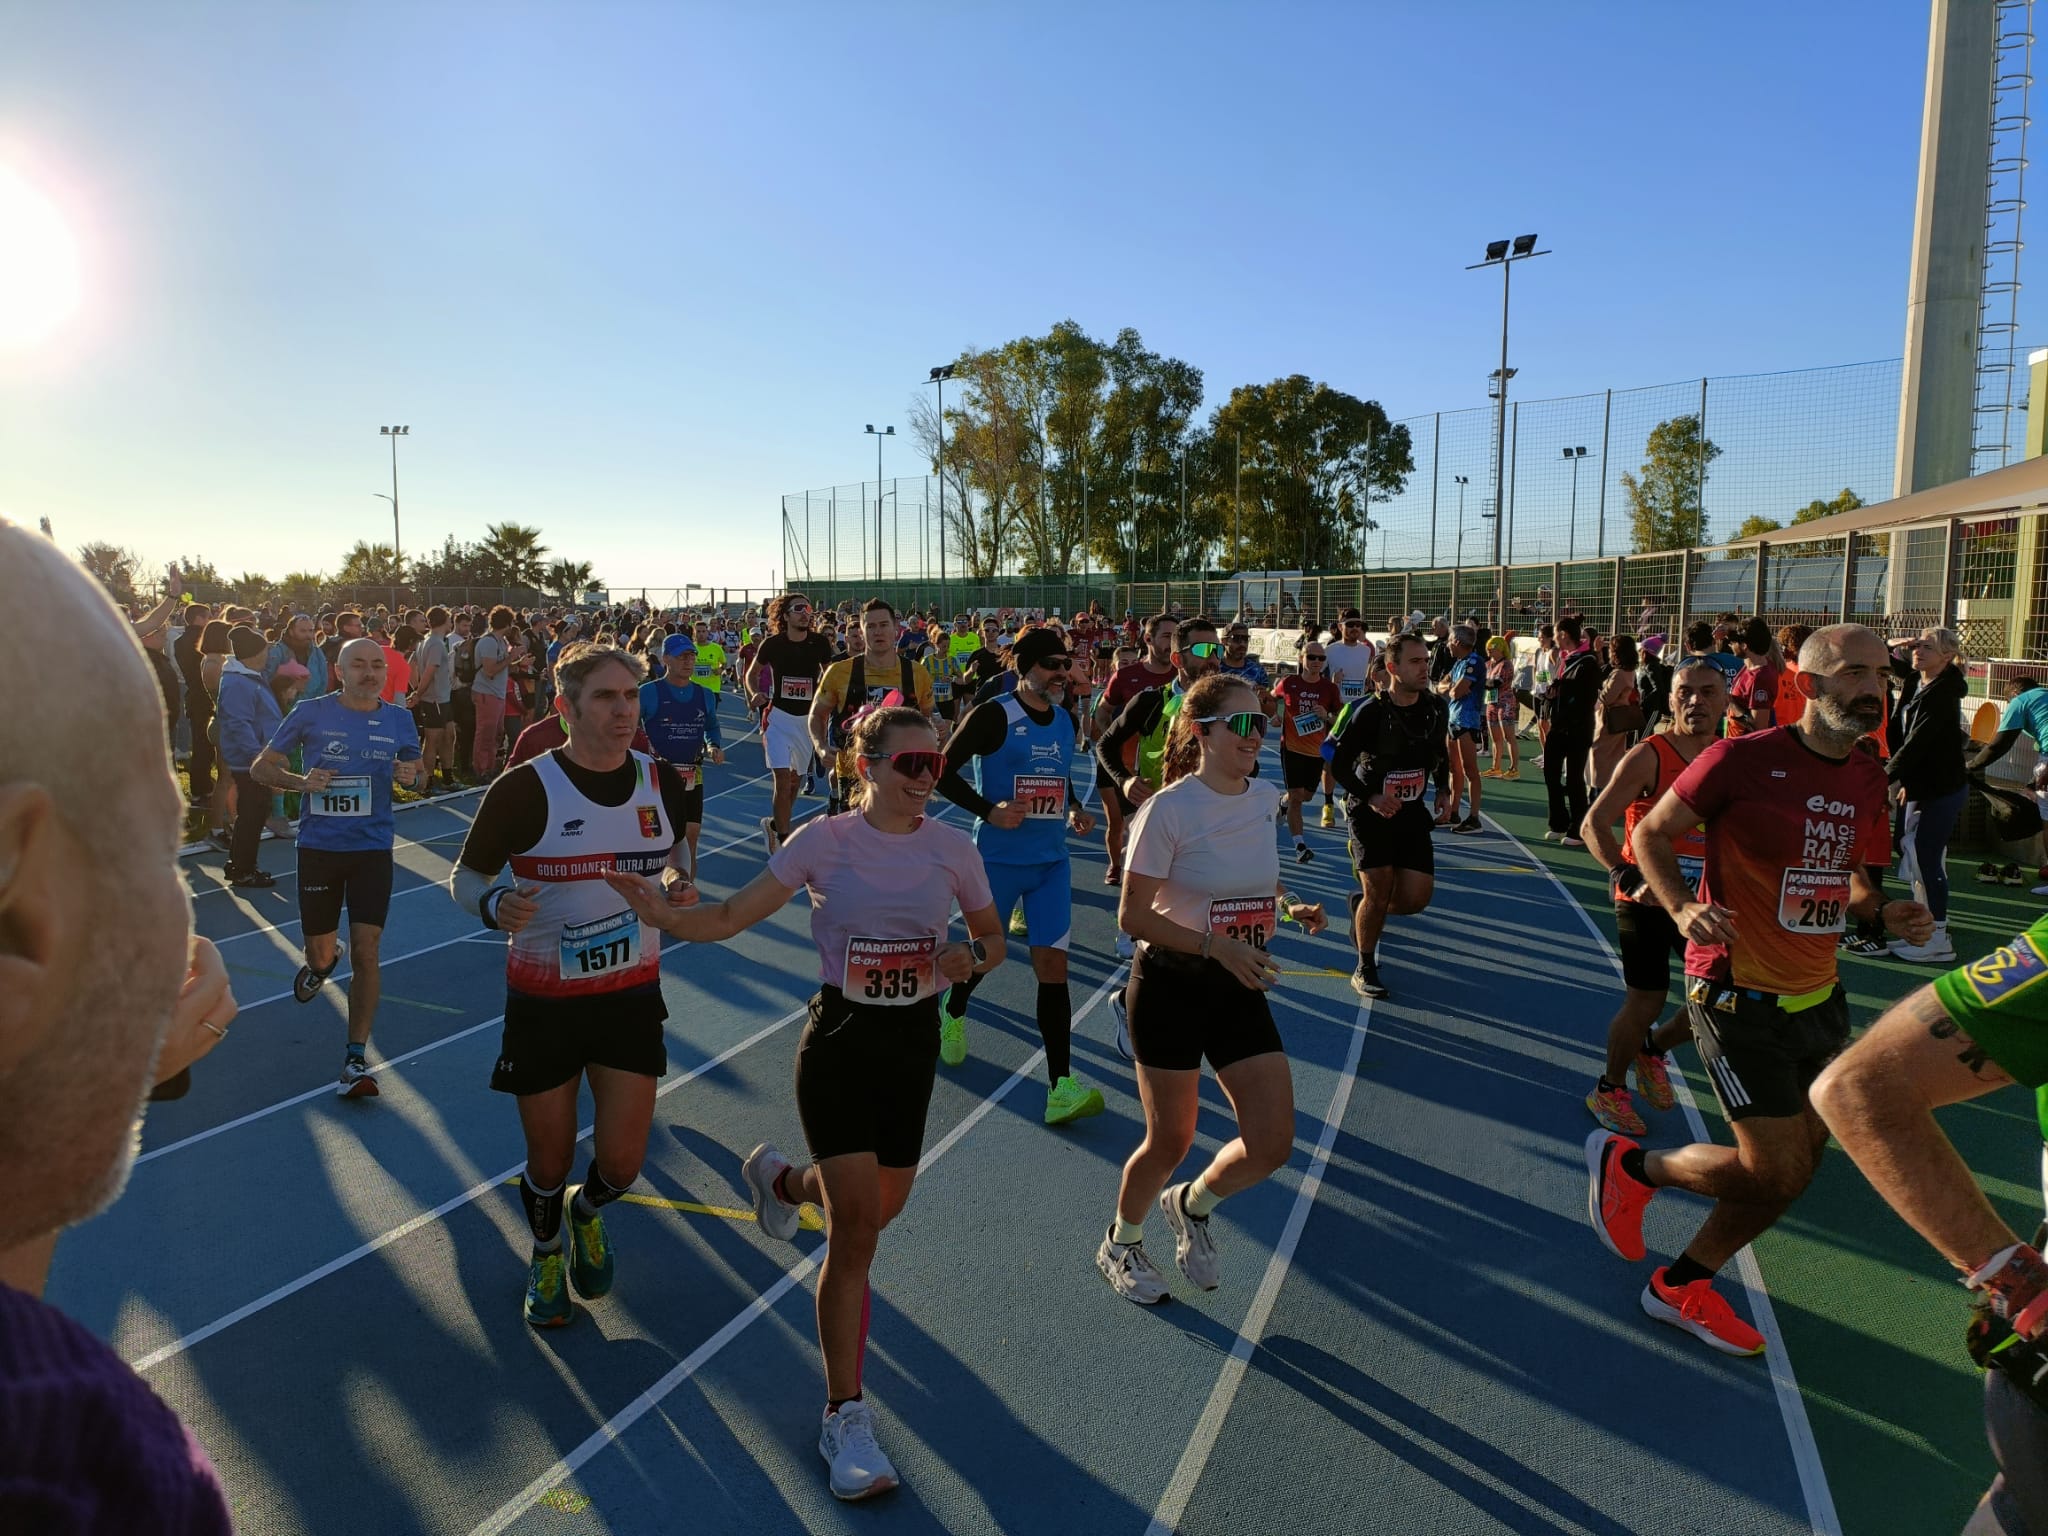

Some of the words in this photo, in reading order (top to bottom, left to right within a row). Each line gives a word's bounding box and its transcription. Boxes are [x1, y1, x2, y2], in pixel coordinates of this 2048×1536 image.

[788, 686, 806, 698] 348
[1344, 688, 1362, 697] 1085
[1302, 720, 1322, 734] 1185
[1394, 784, 1417, 798] 331
[321, 795, 360, 813] 1151
[1031, 796, 1056, 815] 172
[537, 863, 568, 877] GOLFO
[571, 859, 612, 875] DIANESE
[616, 858, 644, 872] ULTRA
[1787, 874, 1842, 886] MARATHON
[1211, 901, 1264, 913] MARATHON
[1799, 899, 1840, 927] 269
[563, 914, 624, 938] ALF-MARATHON
[1226, 923, 1265, 949] 336
[576, 936, 630, 973] 1577
[851, 942, 920, 954] MARATHON
[864, 967, 918, 999] 335
